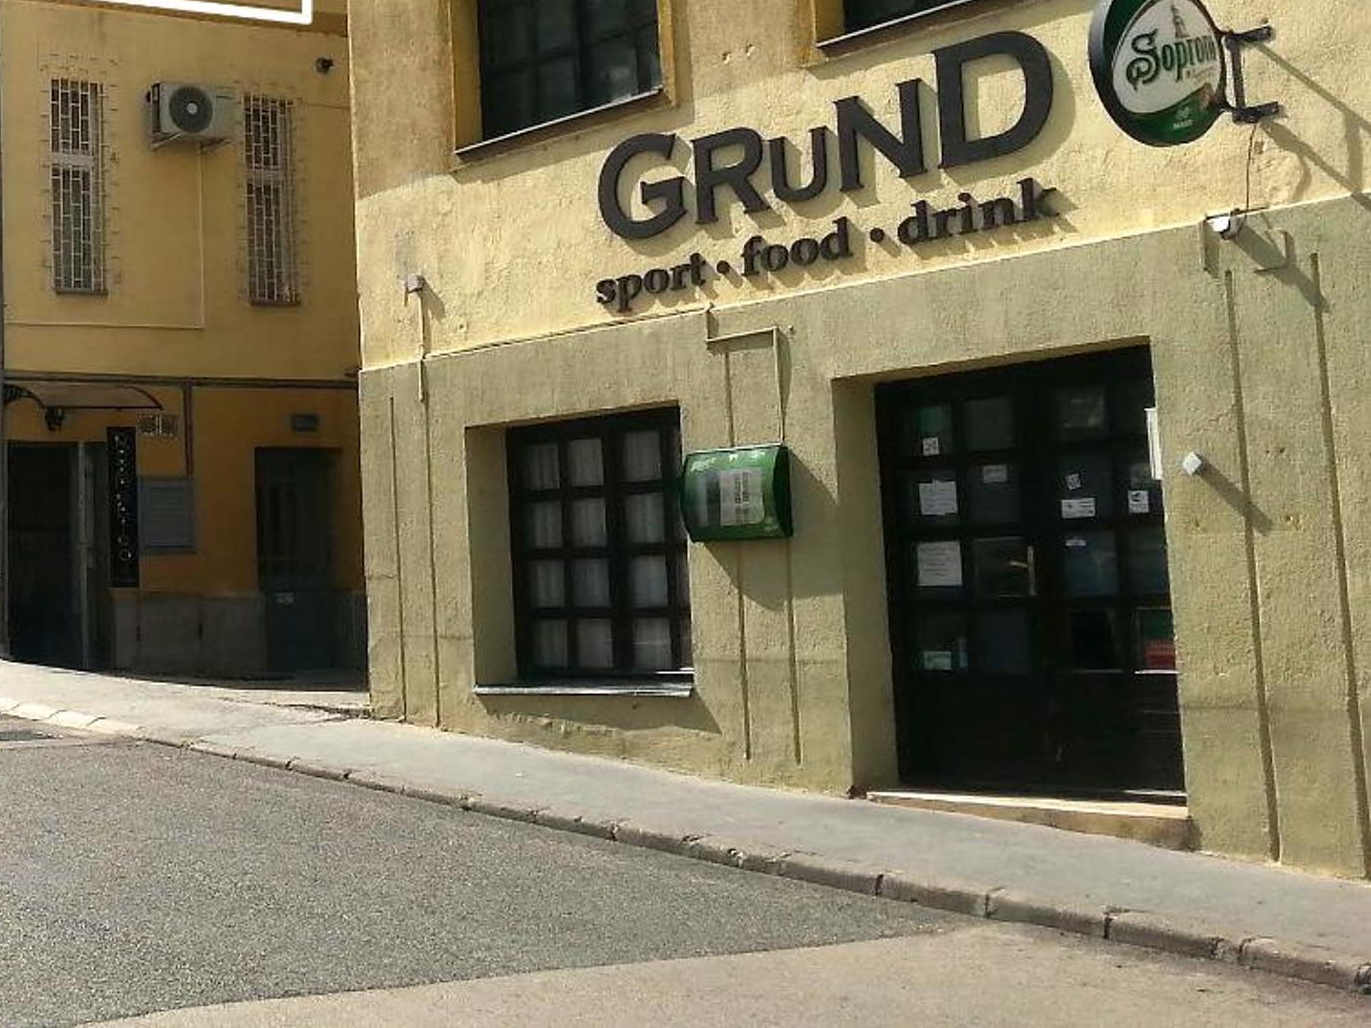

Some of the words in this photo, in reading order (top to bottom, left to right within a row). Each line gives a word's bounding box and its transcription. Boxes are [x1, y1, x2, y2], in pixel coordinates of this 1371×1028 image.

[598, 30, 1054, 240] GRUND
[596, 253, 706, 312] sport
[741, 216, 852, 276] food
[897, 177, 1060, 246] drink
